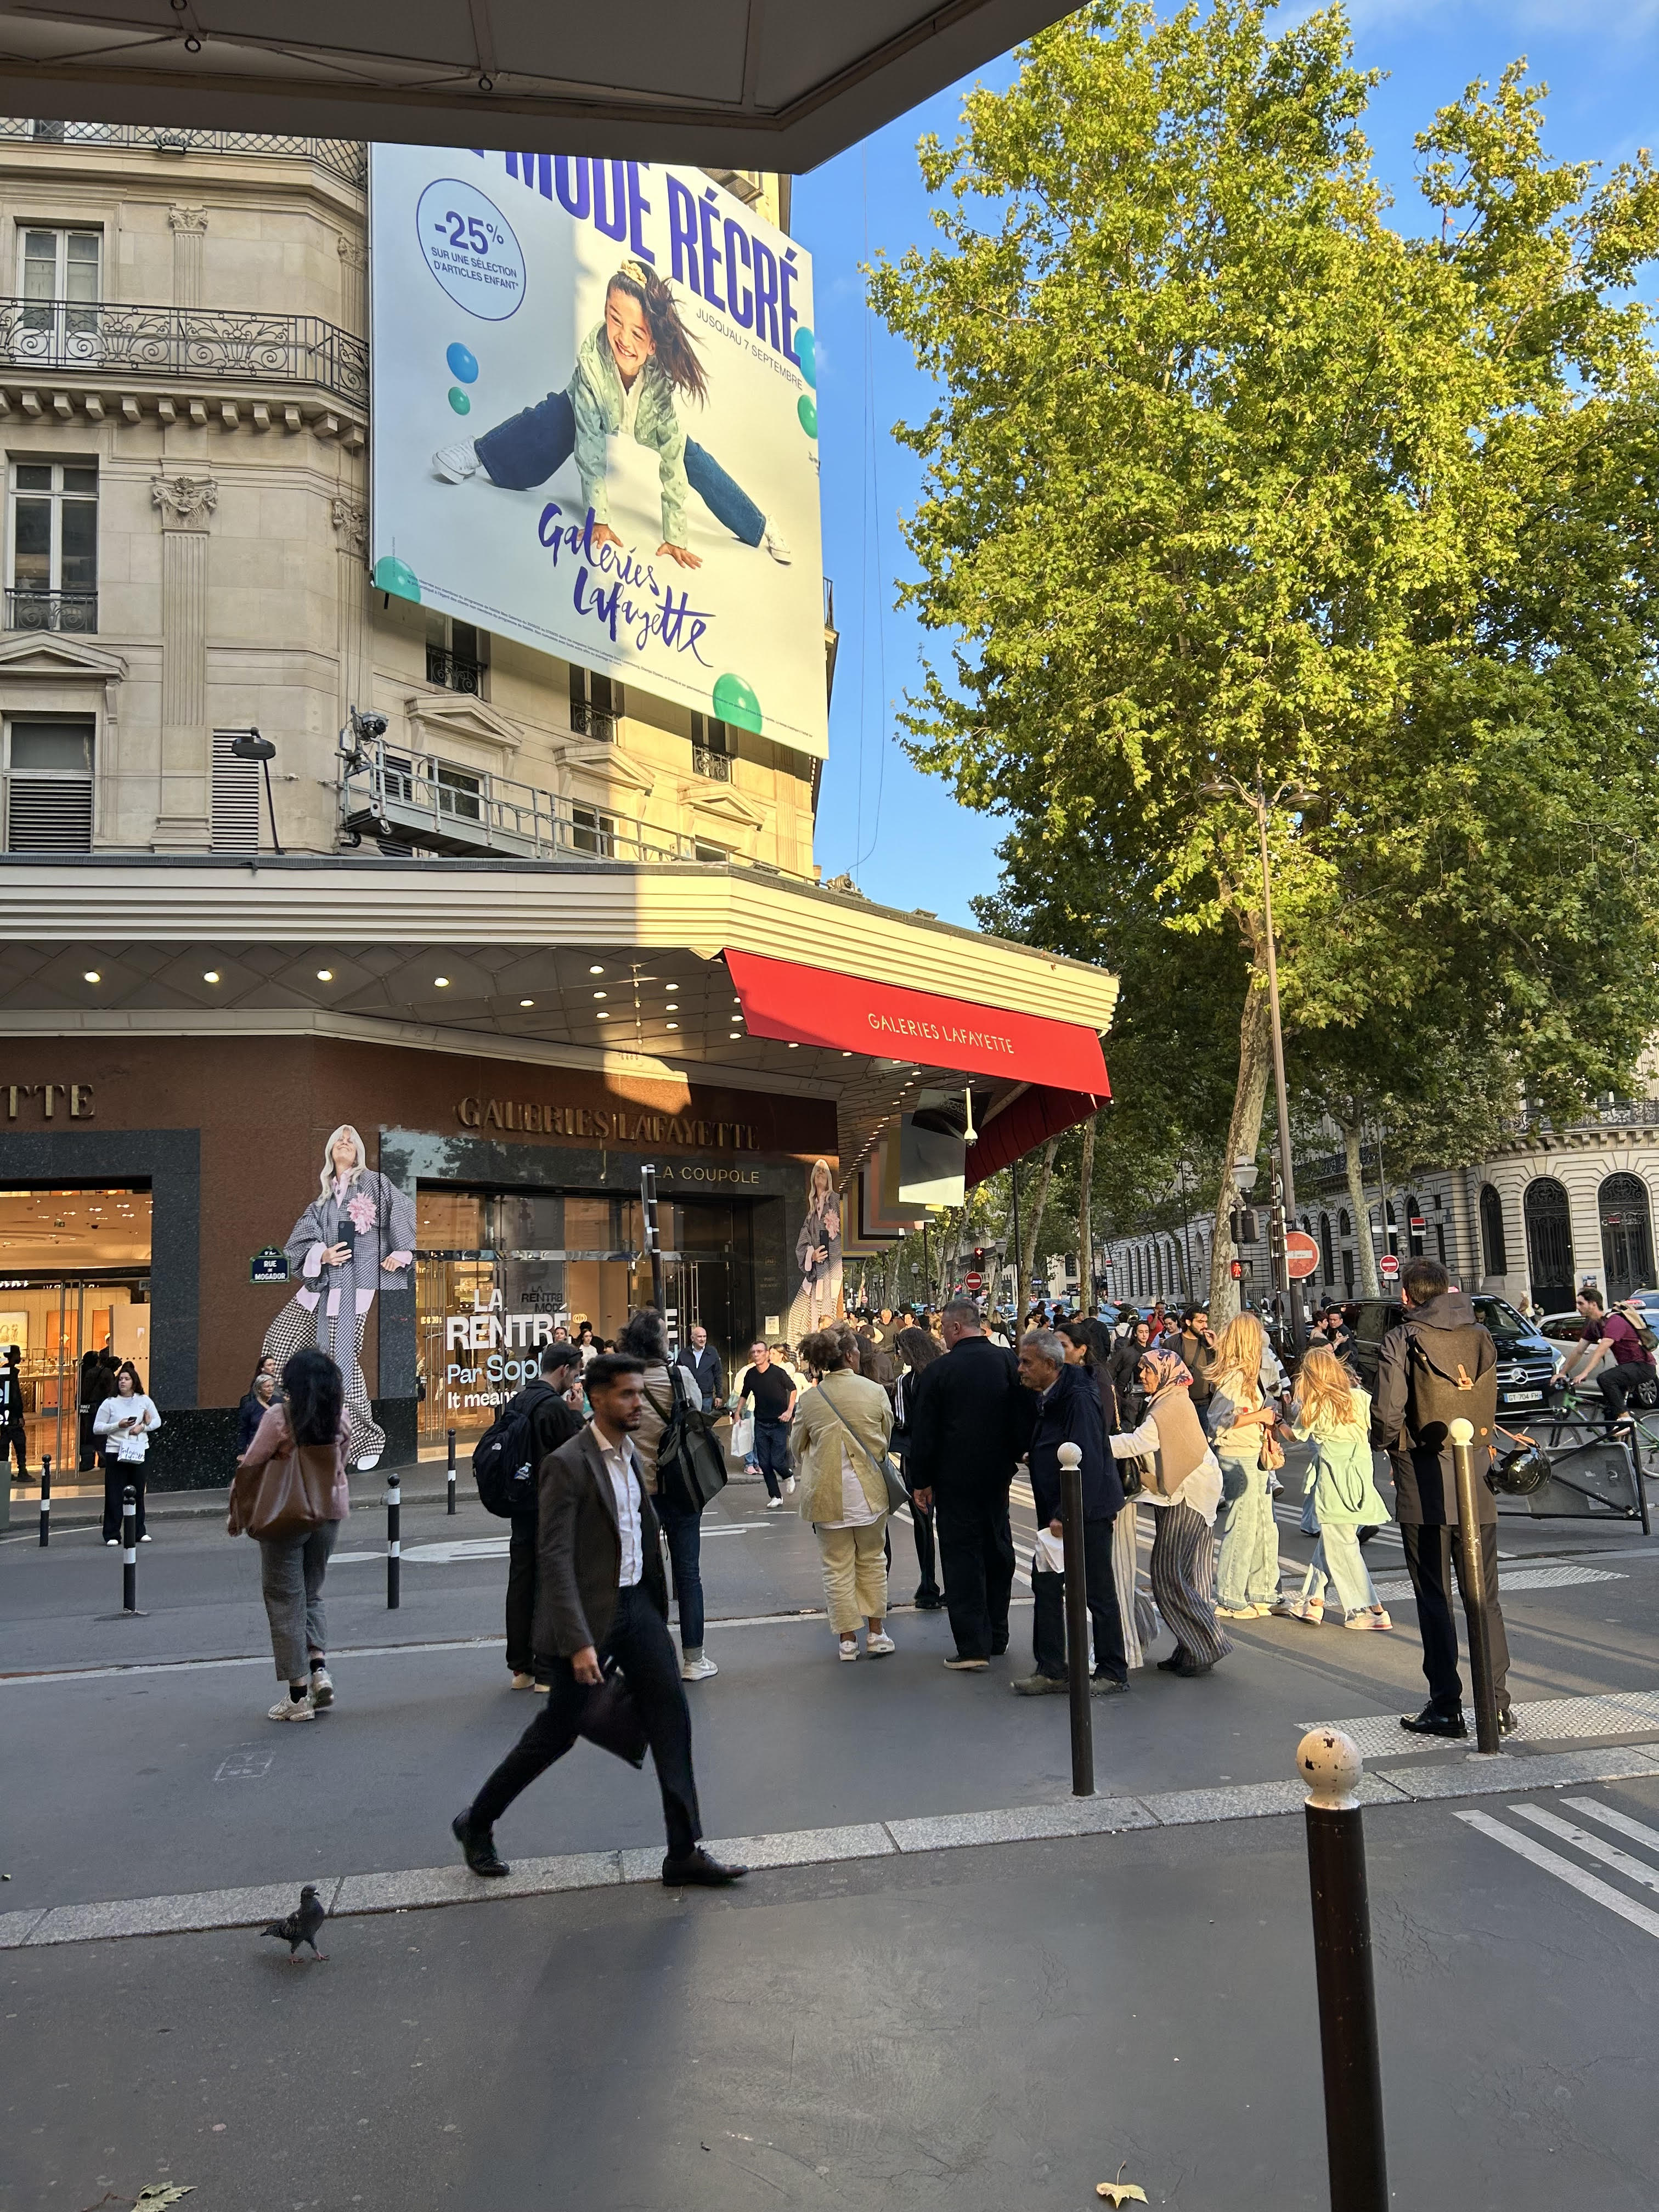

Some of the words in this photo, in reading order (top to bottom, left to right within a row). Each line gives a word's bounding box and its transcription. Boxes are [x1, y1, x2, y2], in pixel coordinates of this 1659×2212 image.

[435, 211, 504, 255] -25%
[431, 247, 450, 259] SUR
[452, 252, 470, 265] UNE
[471, 257, 517, 278] SÉLECTION
[434, 261, 482, 281] D'ARTICLES
[666, 172, 801, 368] RÉCRÉ
[696, 308, 741, 345] JUSQU'AU
[744, 340, 749, 350] 7
[752, 345, 803, 391] SEPTEMBRE
[538, 503, 659, 596] Galeries
[573, 566, 716, 667] Lafayette
[868, 1013, 939, 1040] GALERIES
[942, 1026, 1014, 1054] LAFAYETTE
[0, 1085, 95, 1117] TTE
[459, 1097, 610, 1138] GALERIES
[618, 1113, 760, 1150] LAFAYETTE
[655, 1166, 674, 1179] A
[681, 1167, 759, 1183] COUPOLE
[474, 1289, 503, 1312] LA
[447, 1364, 482, 1385] Par
[448, 1391, 460, 1409] It
